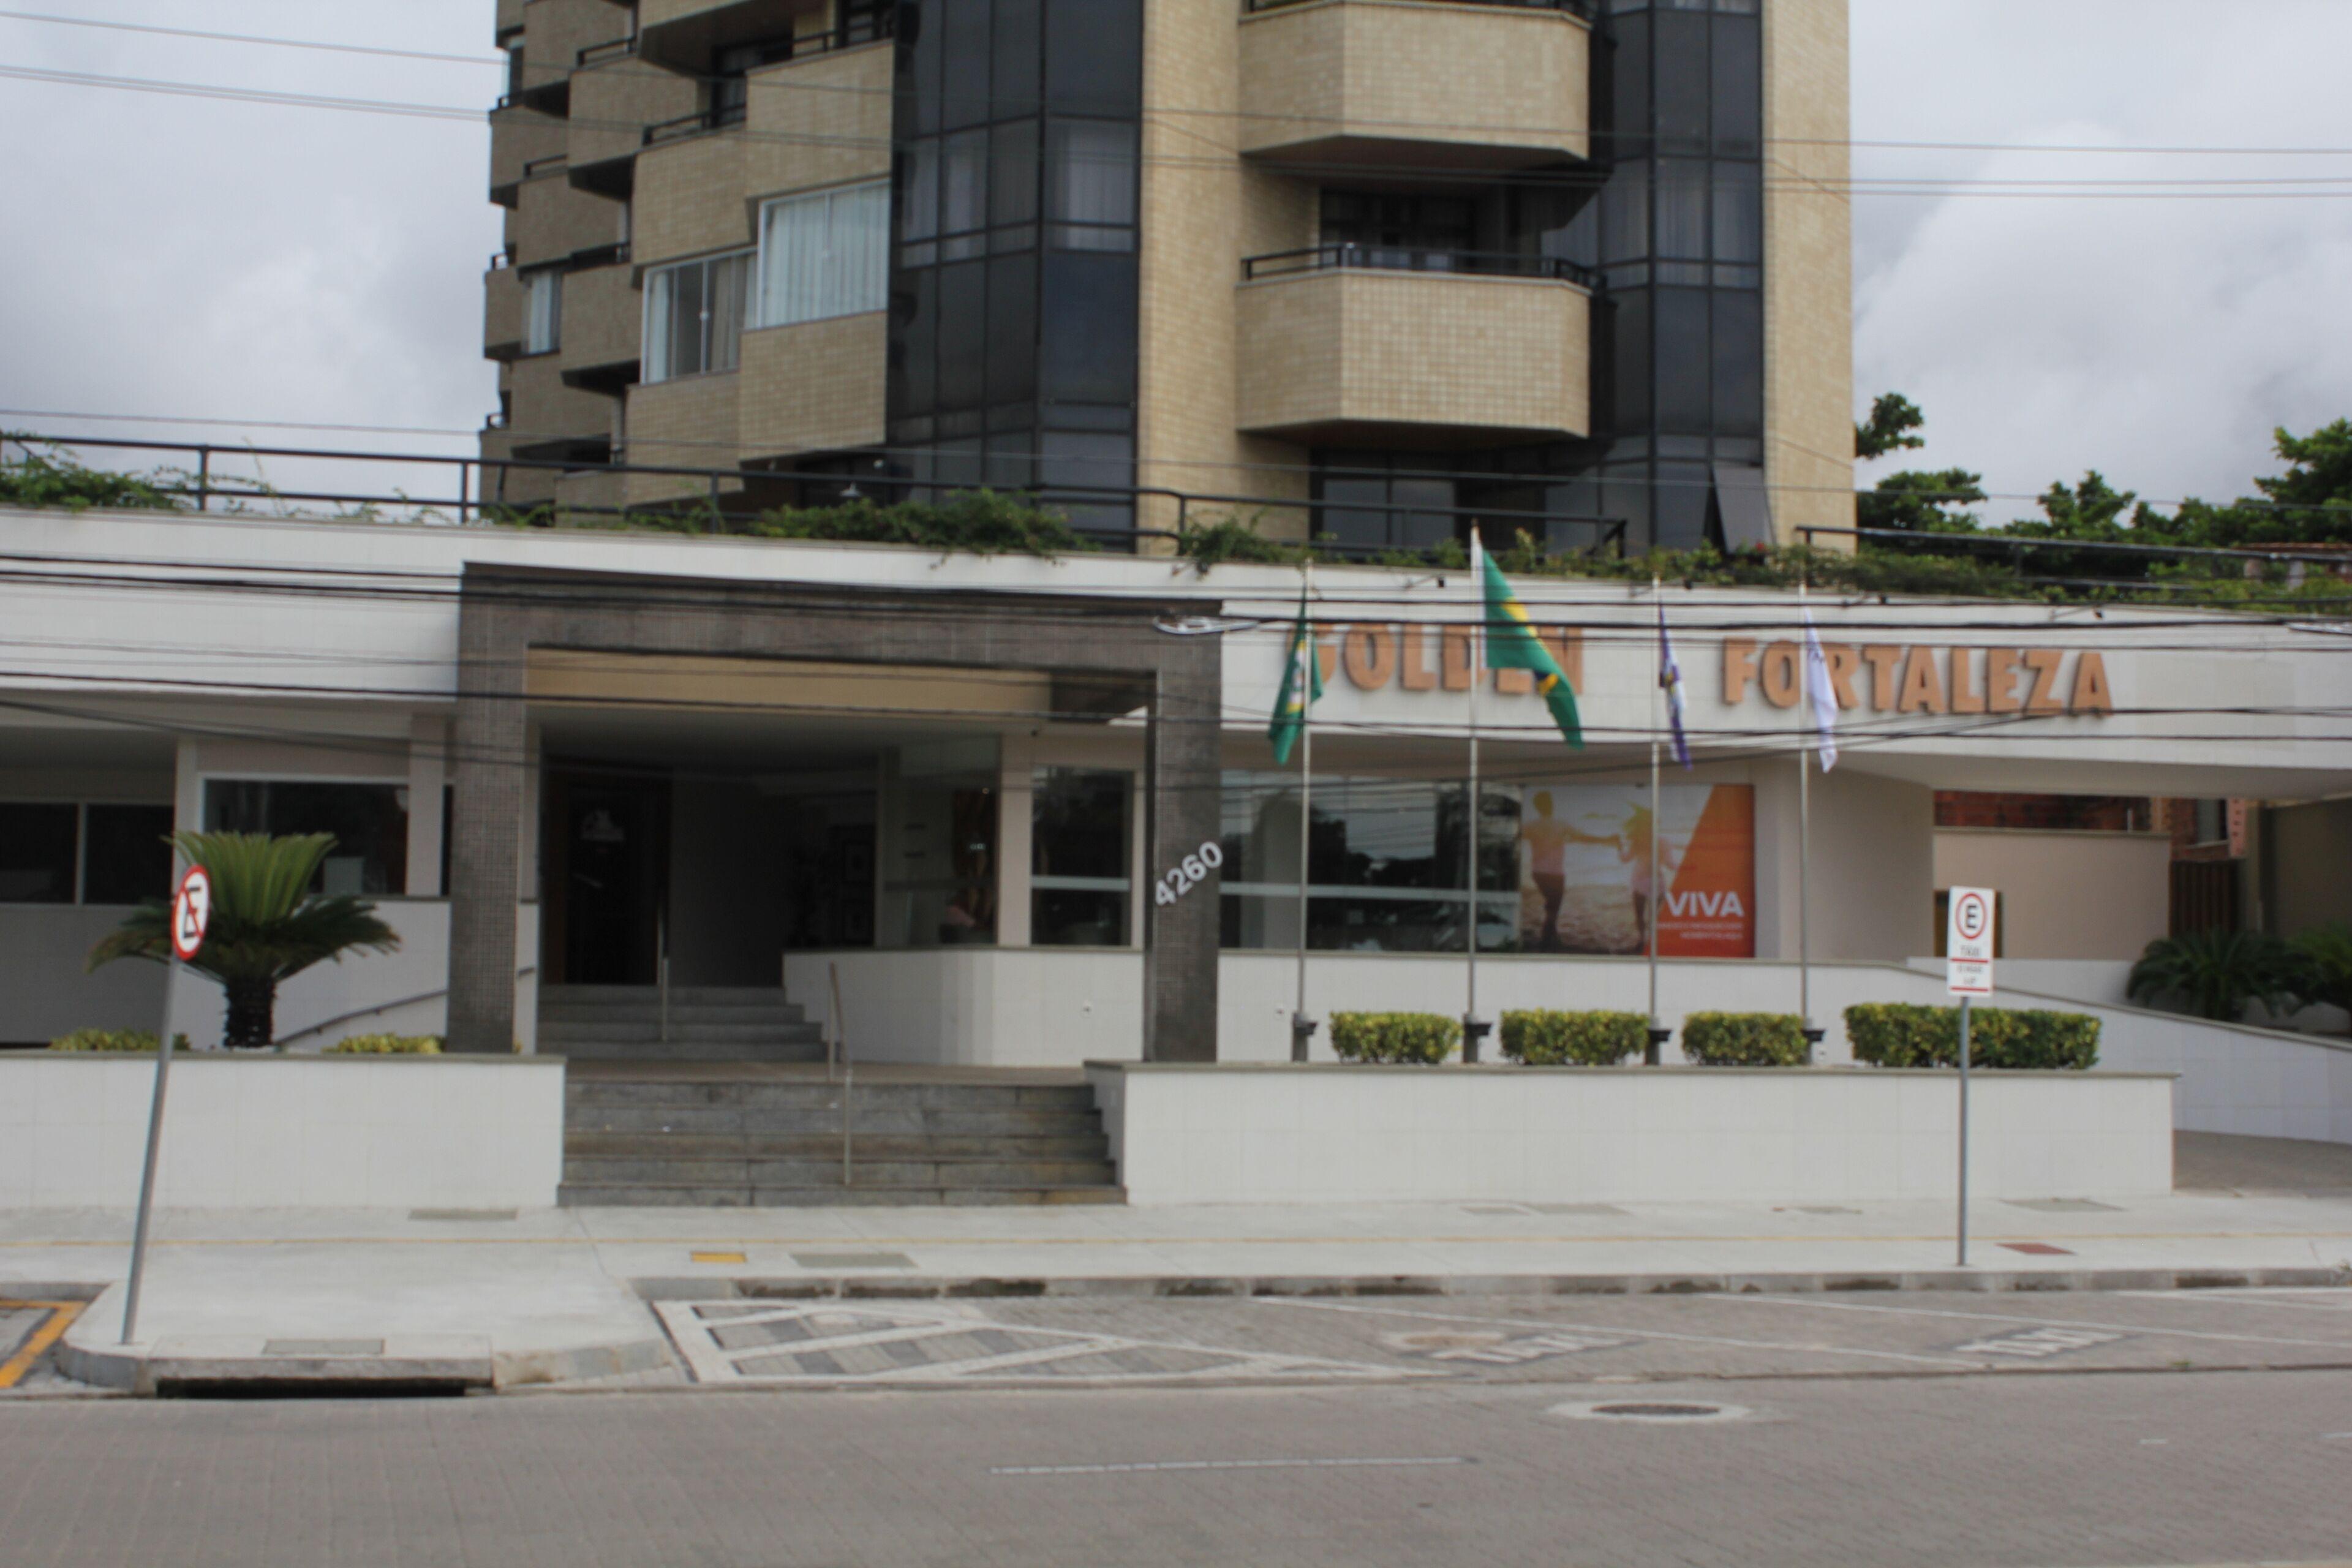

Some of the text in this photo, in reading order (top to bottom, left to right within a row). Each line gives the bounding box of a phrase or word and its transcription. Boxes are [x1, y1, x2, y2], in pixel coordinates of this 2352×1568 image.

[1722, 637, 2113, 717] FORTALEZA
[1155, 841, 1223, 906] 4260
[1665, 891, 1744, 917] VIVA
[1966, 904, 1978, 929] E
